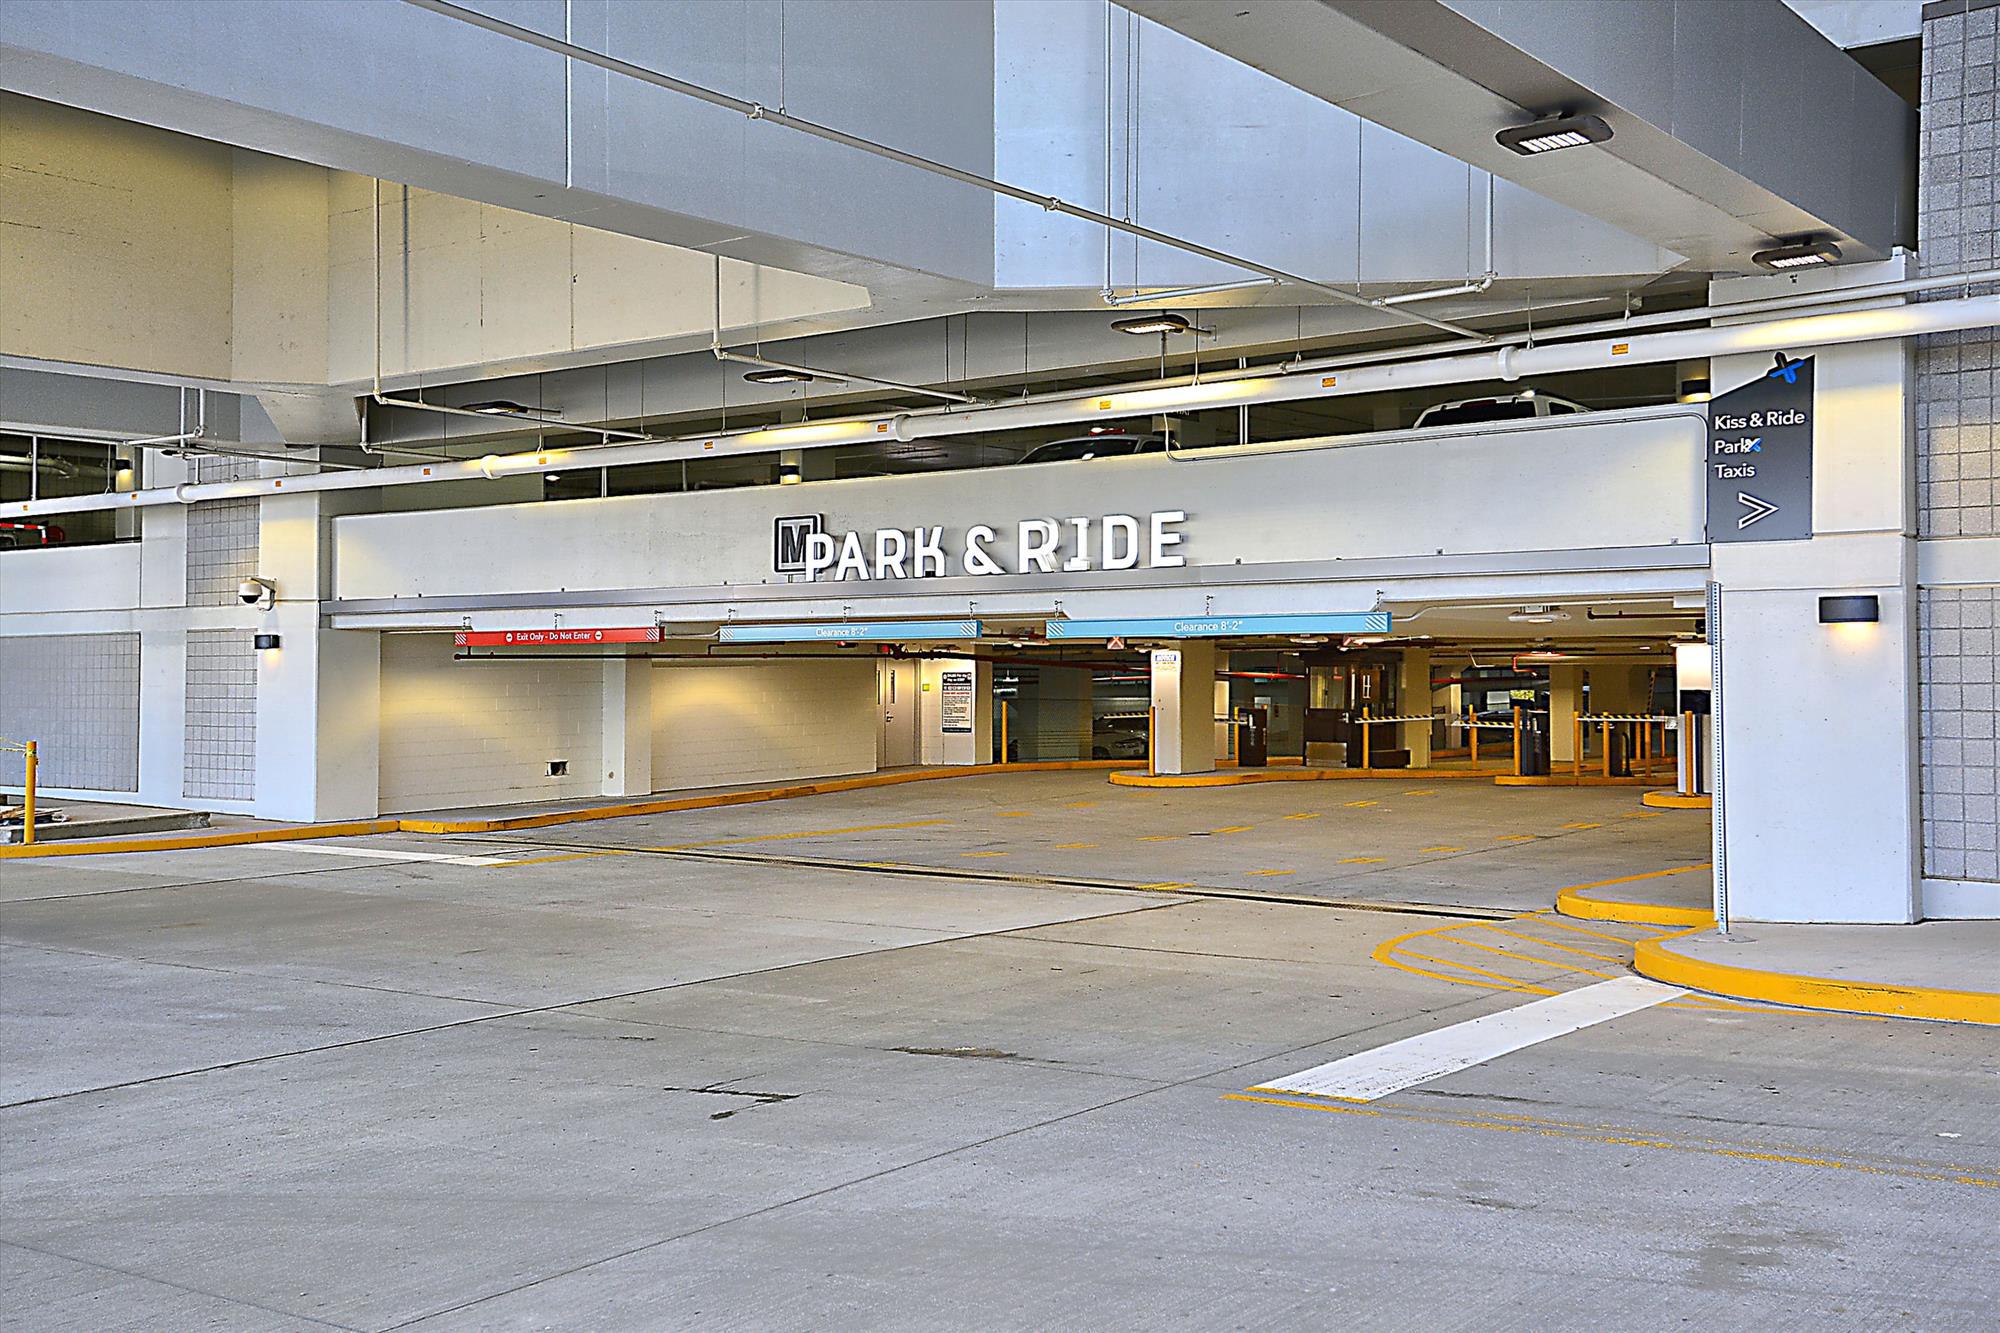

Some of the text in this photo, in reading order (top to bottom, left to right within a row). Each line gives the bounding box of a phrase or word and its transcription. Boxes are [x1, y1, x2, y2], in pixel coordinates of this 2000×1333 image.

[1714, 409, 1806, 430] Kiss & Ride
[1714, 462, 1756, 479] Taxis
[805, 510, 1187, 582] PARK & RIDE
[815, 627, 850, 637] Clearance
[1174, 621, 1218, 632] Clearance
[516, 632, 529, 641] Exit
[529, 632, 544, 642] Only
[549, 632, 559, 640] Do
[560, 631, 572, 640] Not
[573, 631, 591, 640] Enter
